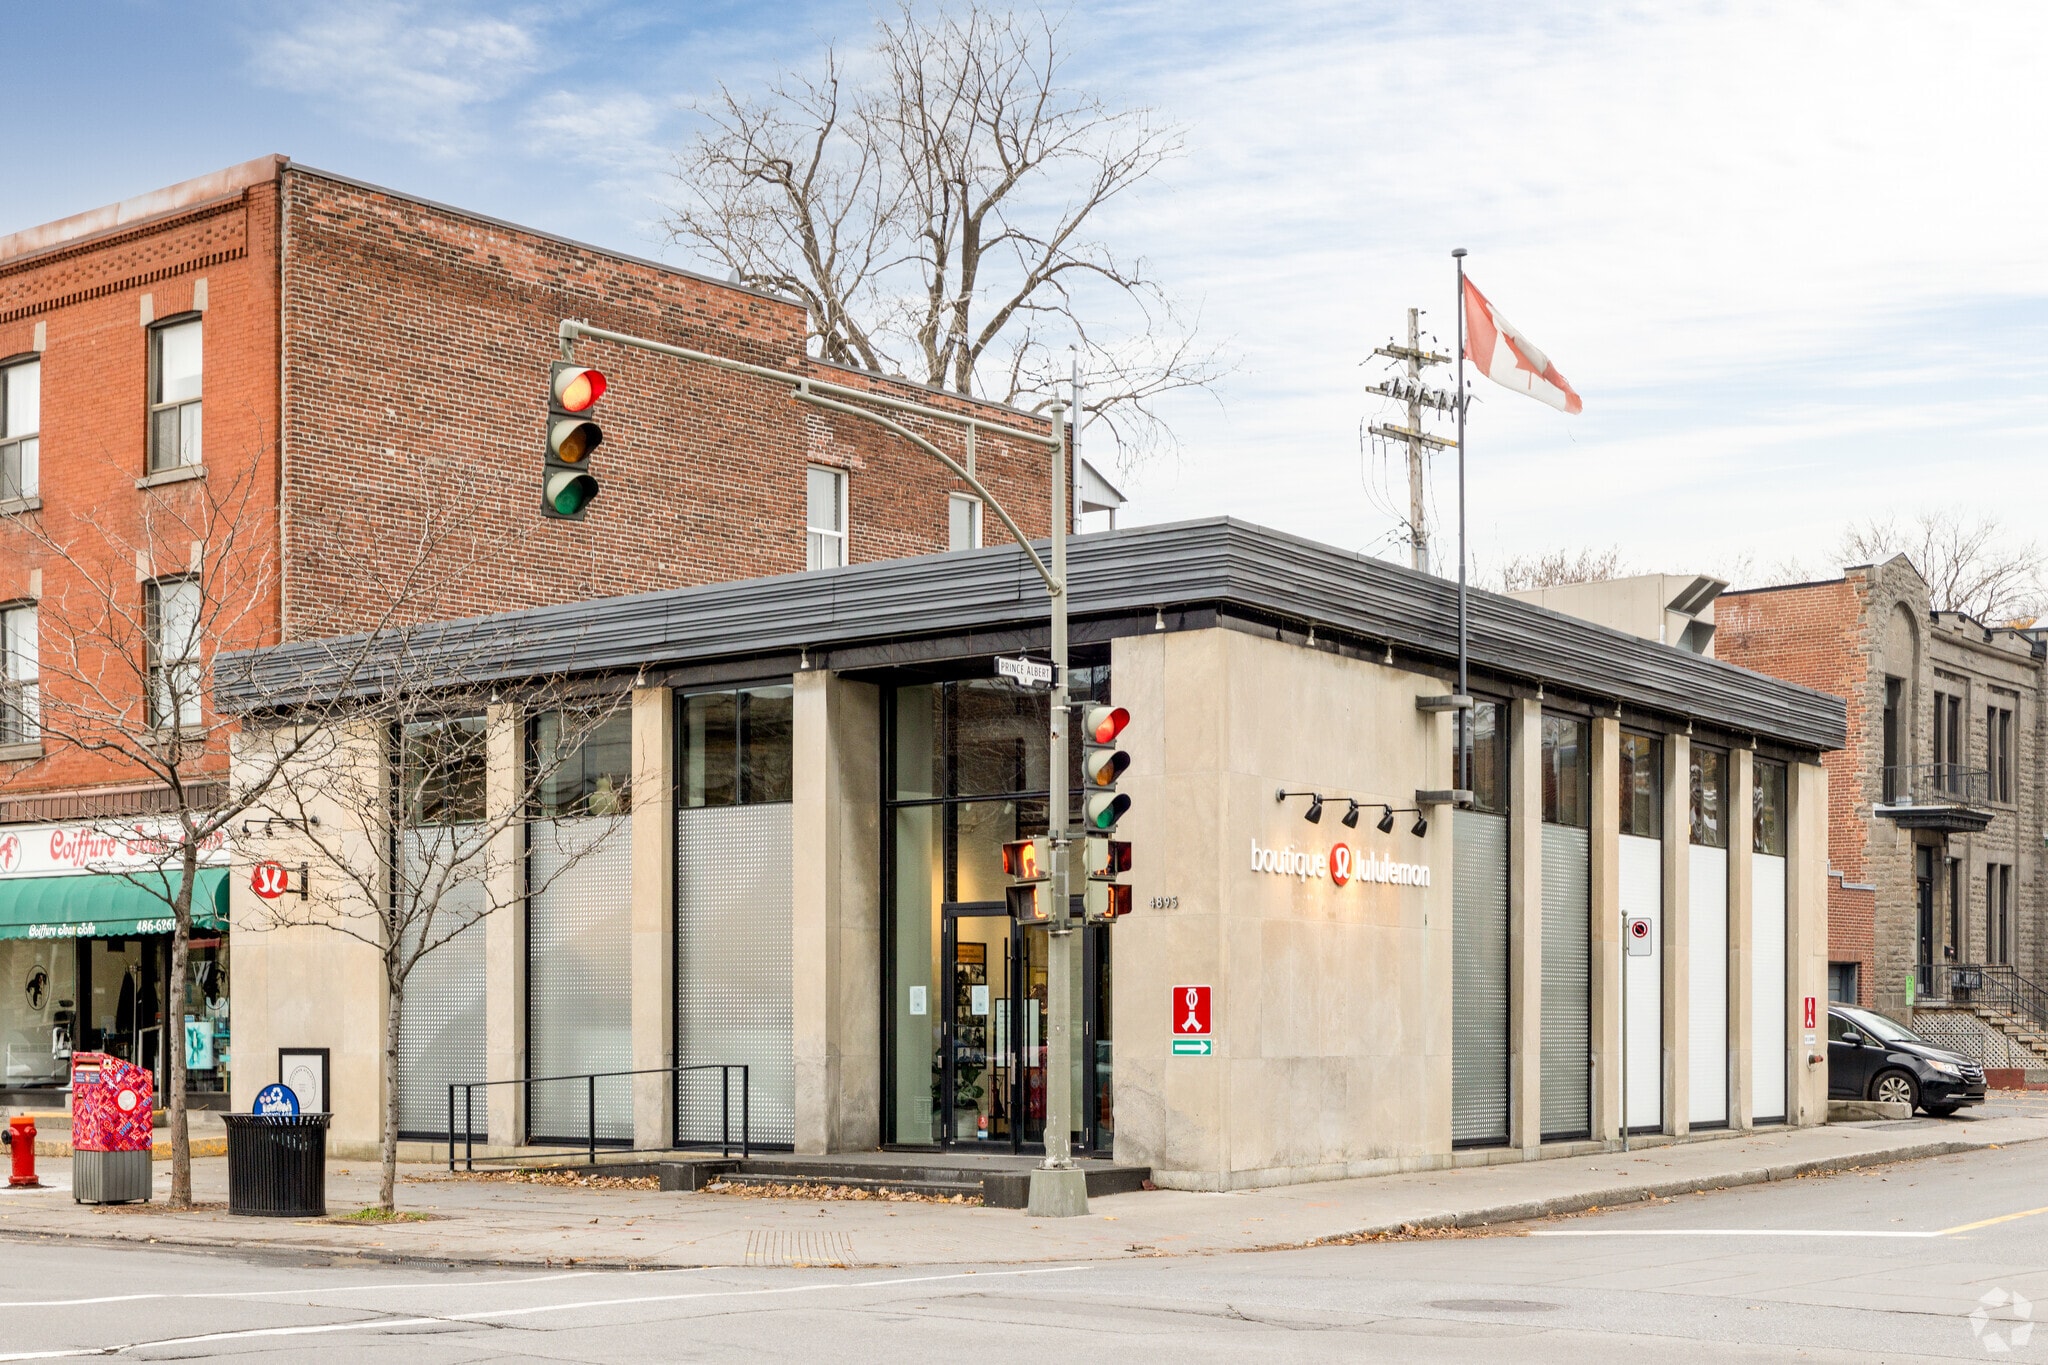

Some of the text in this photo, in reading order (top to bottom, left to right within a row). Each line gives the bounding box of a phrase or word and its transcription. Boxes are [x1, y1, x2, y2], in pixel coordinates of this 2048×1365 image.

[1001, 661, 1050, 678] PRINCE ALBERT
[50, 829, 116, 867] Coiffure
[1251, 838, 1431, 887] boutique lululemon
[1149, 895, 1179, 909] 4895
[28, 922, 96, 937] Coiffure Jean John
